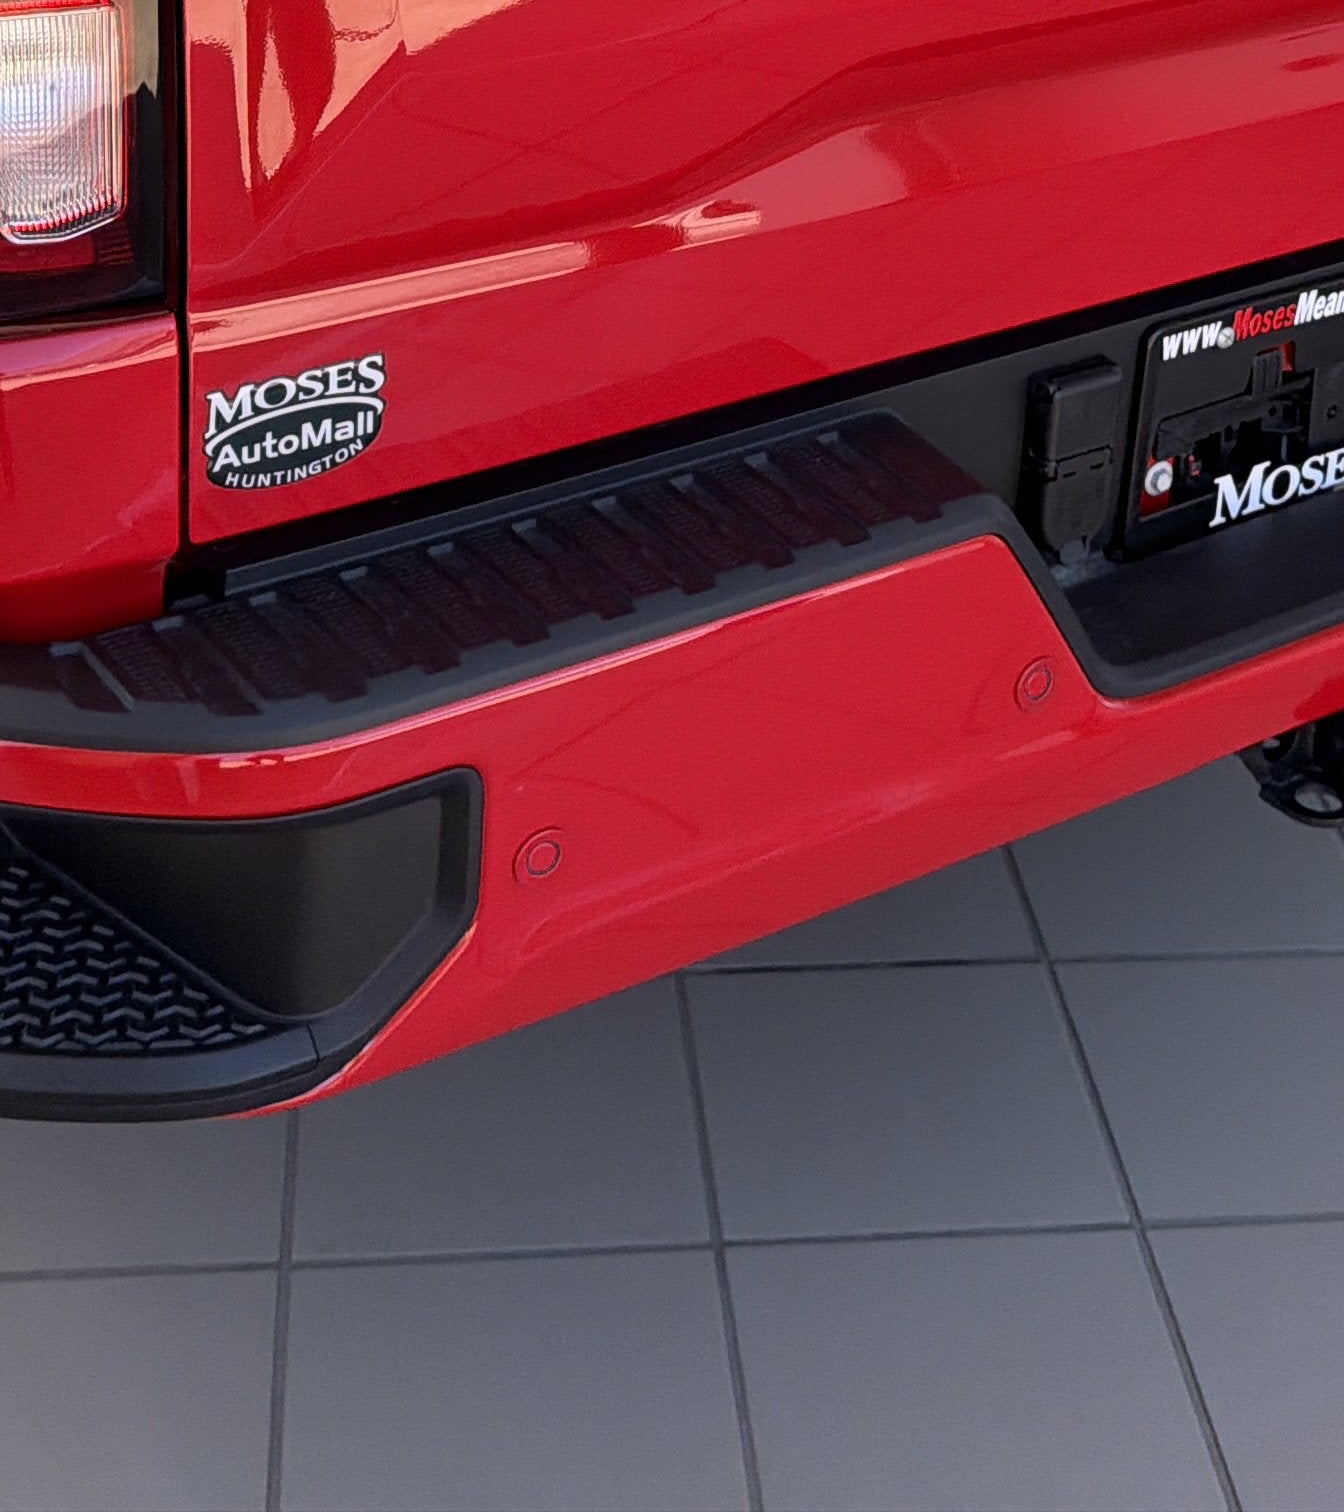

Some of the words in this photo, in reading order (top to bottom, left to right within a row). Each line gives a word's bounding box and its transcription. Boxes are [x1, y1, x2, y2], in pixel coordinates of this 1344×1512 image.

[205, 353, 385, 440] MOSES
[212, 410, 374, 473] AutoMall
[224, 438, 364, 488] HUNTINGTON
